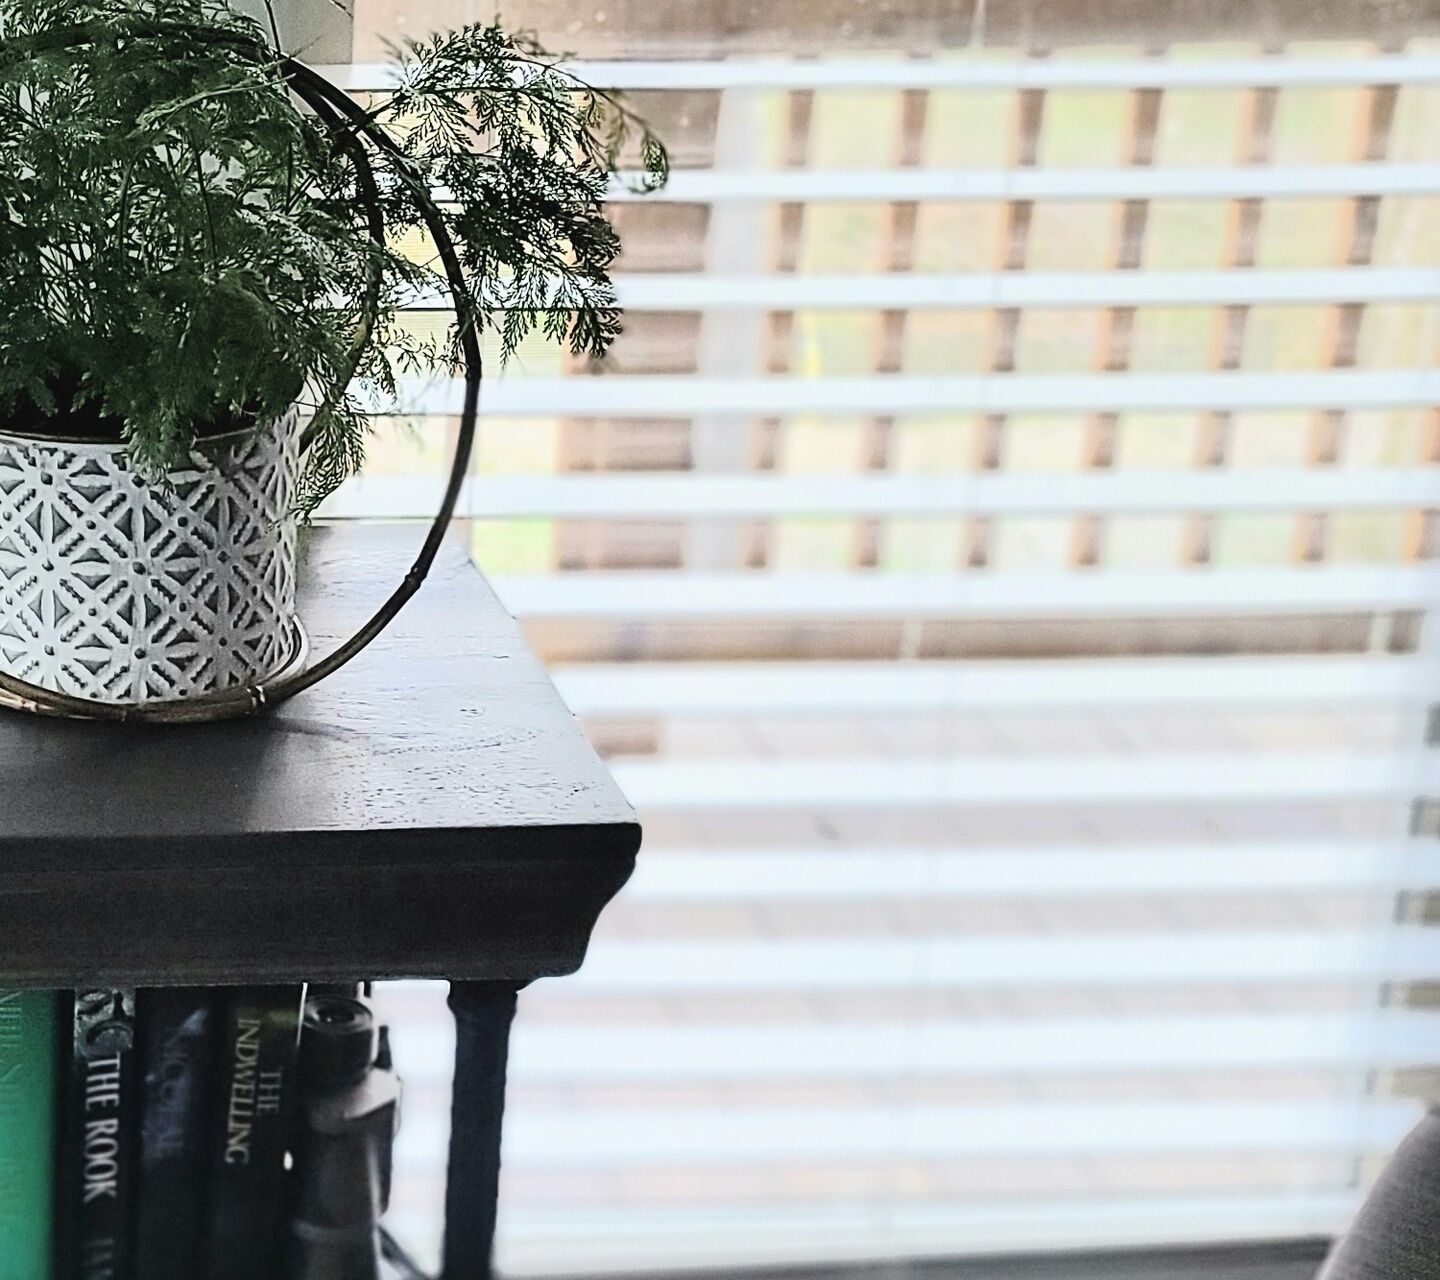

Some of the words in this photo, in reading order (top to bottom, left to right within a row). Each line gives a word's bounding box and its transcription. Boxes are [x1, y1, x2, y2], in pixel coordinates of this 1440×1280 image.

[86, 1052, 120, 1111] THE
[224, 1018, 260, 1164] INDWELLING
[257, 1070, 282, 1115] THE
[84, 1118, 119, 1202] ROOK
